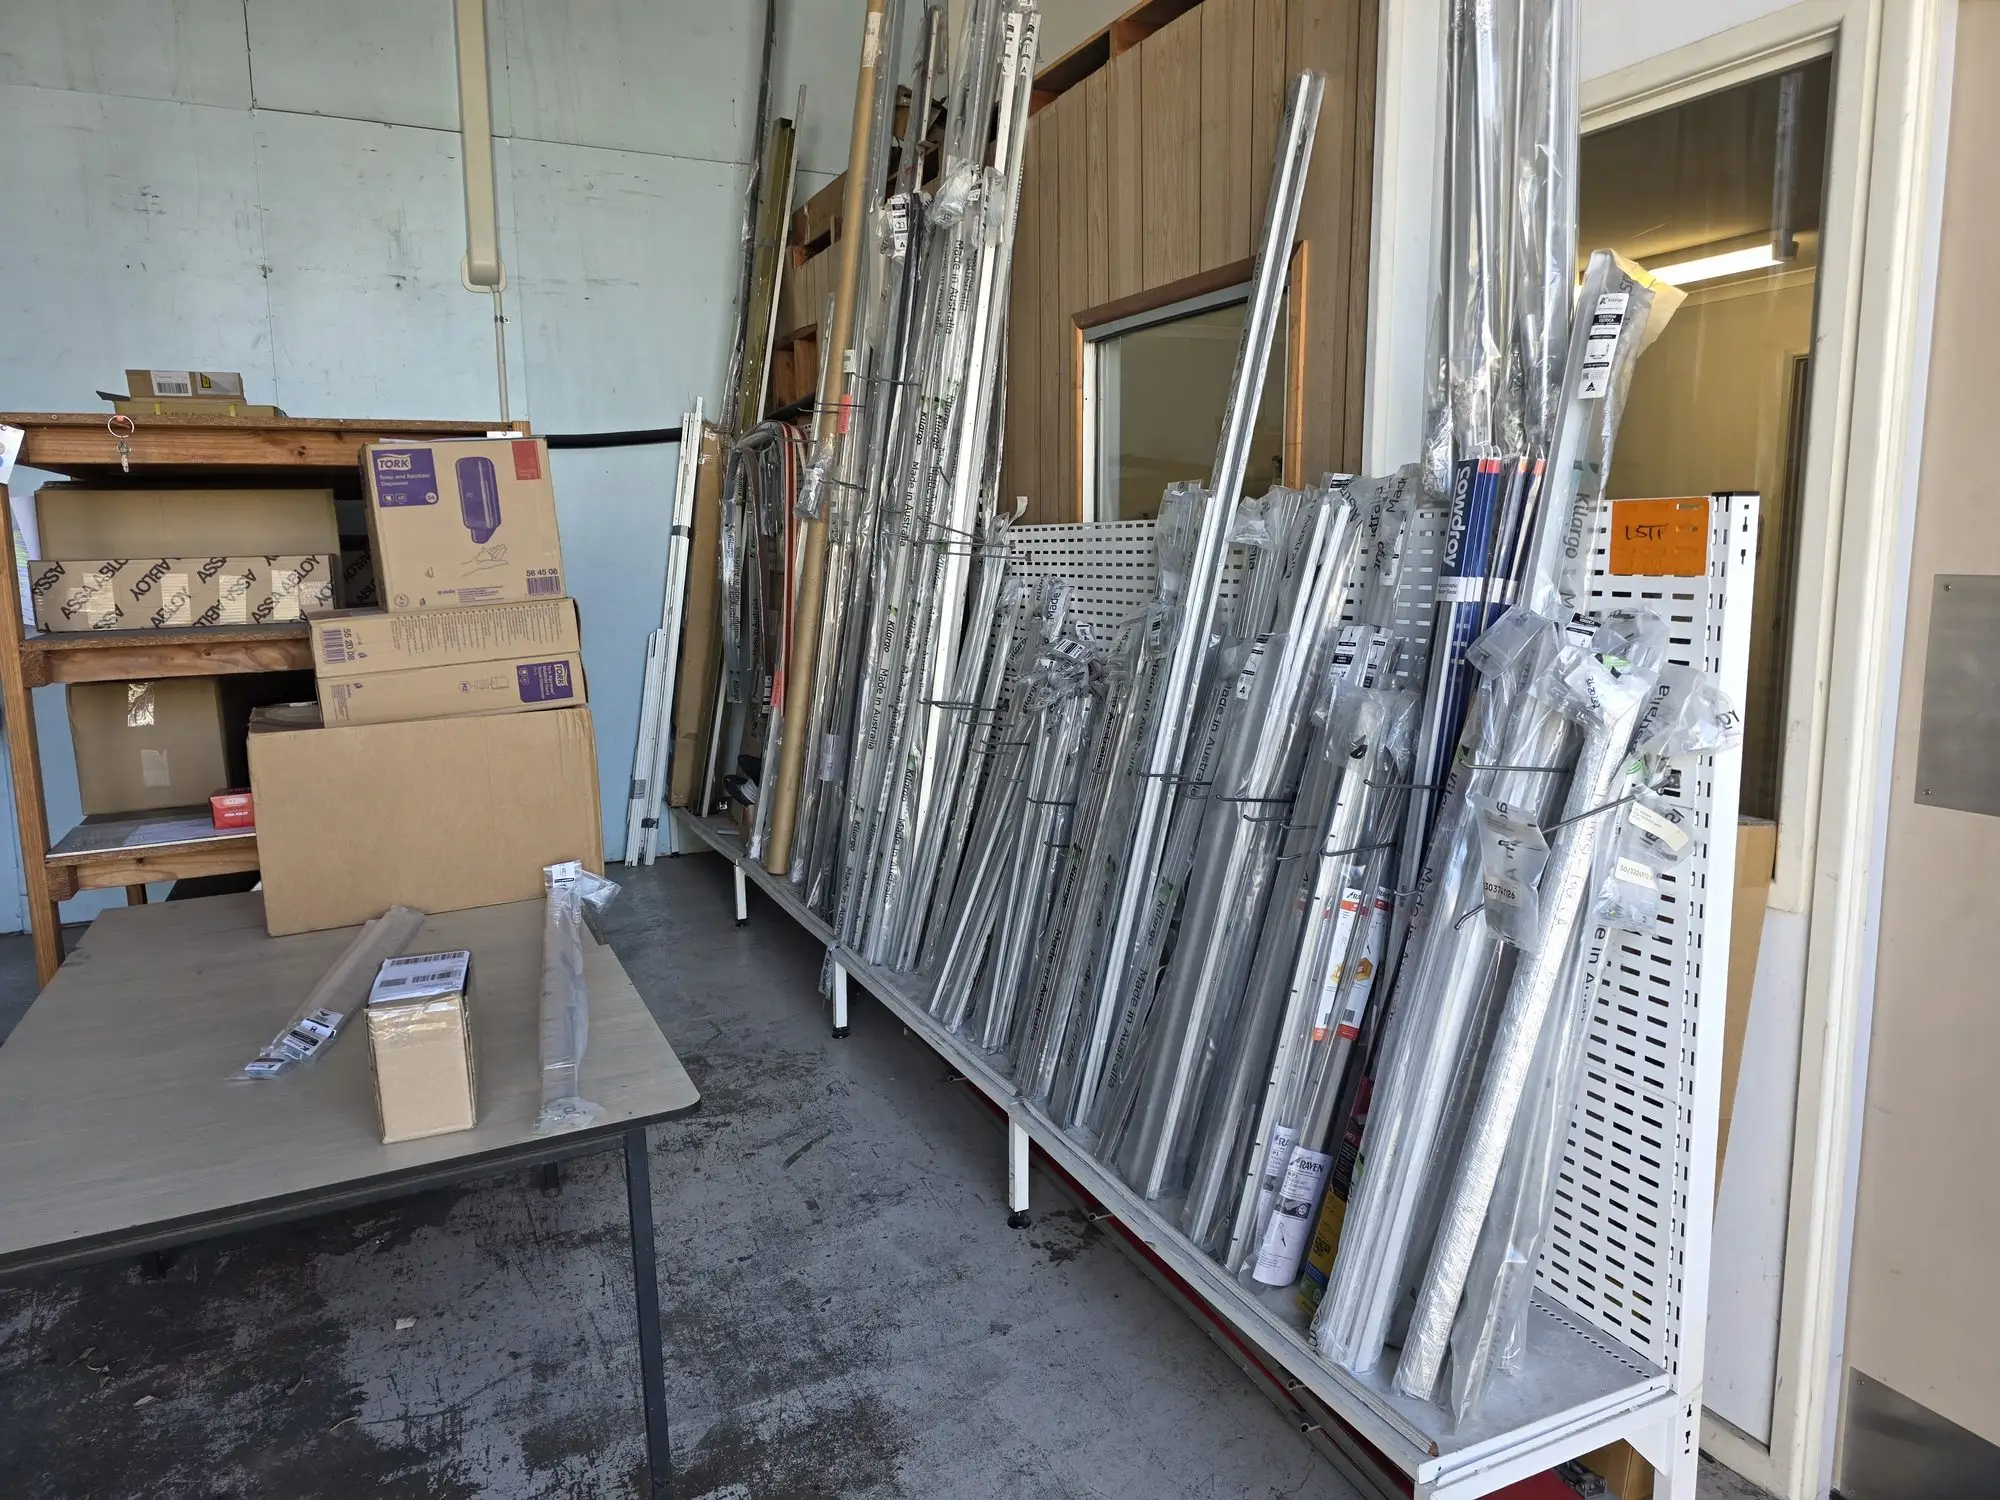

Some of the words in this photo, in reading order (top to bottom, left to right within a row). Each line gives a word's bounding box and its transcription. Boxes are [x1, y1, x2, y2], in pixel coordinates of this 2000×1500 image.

[952, 240, 964, 269] Made
[952, 273, 960, 284] in
[945, 287, 960, 335] Australia
[916, 411, 928, 445] Kilargo
[933, 414, 944, 450] Kilargo
[379, 459, 410, 469] TORK
[908, 461, 920, 488] Made
[906, 491, 913, 502] in
[900, 504, 914, 548] Australia
[1563, 493, 1590, 560] Kilargo
[130, 558, 172, 602] ABLOY
[538, 568, 548, 576] 45
[60, 585, 98, 620] ASSA
[98, 559, 130, 590] ABLO
[251, 591, 284, 624] ASSA
[281, 556, 320, 595] ABLOY
[1048, 591, 1061, 620] Made
[344, 628, 351, 640] 55
[346, 640, 354, 650] 20
[884, 620, 895, 653] Kilargo
[555, 664, 565, 685] TORK
[877, 668, 890, 694] Made
[874, 697, 881, 706] in
[868, 710, 881, 750] Australia
[1212, 720, 1222, 734] in
[850, 820, 861, 852] Kilargo
[842, 866, 853, 892] Made
[1062, 865, 1078, 909] Kilargo
[840, 894, 847, 904] in
[1147, 901, 1167, 948] Kilargo
[1047, 929, 1063, 964] Made
[1041, 964, 1052, 981] in
[1130, 968, 1148, 1008] Made
[1030, 980, 1049, 1041] Australia
[1126, 1009, 1138, 1025] in
[1108, 1027, 1131, 1090] Australia
[1300, 1160, 1324, 1174] RAVEN
